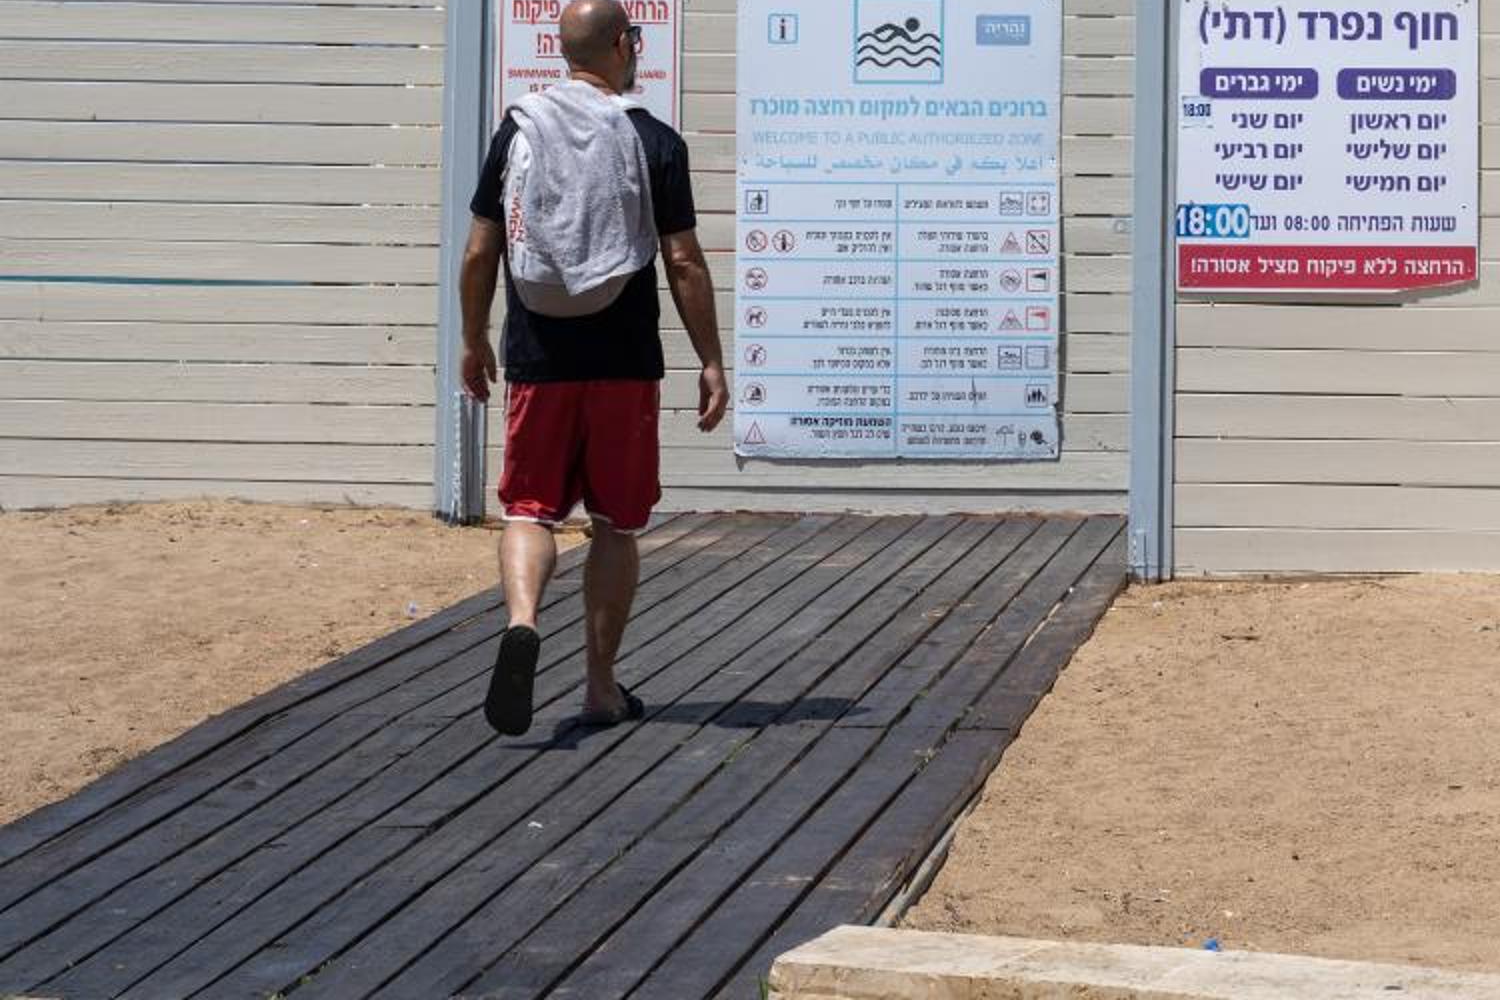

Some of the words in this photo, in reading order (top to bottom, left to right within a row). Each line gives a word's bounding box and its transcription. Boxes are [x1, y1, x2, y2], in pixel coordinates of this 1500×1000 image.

[513, 0, 561, 25] פיקוח
[625, 0, 669, 20] הרחצ
[1298, 10, 1382, 41] נפרד
[1394, 10, 1460, 50] חוף
[508, 69, 561, 79] SWIMMING
[1215, 75, 1269, 91] גברים
[1276, 75, 1303, 92] ימי
[1356, 75, 1404, 92] נשים
[1410, 76, 1437, 92] ימי
[750, 98, 799, 116] מוכרז
[804, 99, 854, 116] רחצה
[860, 95, 920, 120] למקום
[925, 99, 983, 116] הבאים
[989, 100, 1047, 117] ברוכים
[1231, 113, 1268, 129] שני
[1274, 113, 1303, 129] יום
[1350, 113, 1411, 134] ראשון
[1418, 113, 1447, 130] יום
[752, 130, 818, 145] WELCOME
[823, 131, 841, 144] TO
[845, 132, 854, 144] A
[858, 131, 905, 145] PUBLIC
[1008, 132, 1043, 146] ZONE
[1214, 143, 1268, 160] רביעי
[1274, 143, 1303, 159] יום
[1345, 140, 1411, 160] שלישי
[1418, 143, 1447, 160] יום
[1215, 174, 1267, 190] שישי
[1274, 174, 1303, 190] יום
[1345, 175, 1411, 192] חמישי
[1418, 175, 1447, 192] יום
[1177, 206, 1249, 236] 18:00
[1284, 215, 1330, 231] 08:00
[1338, 216, 1403, 232] הפתיחה
[1411, 216, 1457, 232] שעות
[1191, 257, 1251, 273] אסורה!
[1257, 257, 1299, 274] מציל
[1306, 259, 1356, 277] פיקוח
[1363, 257, 1397, 274] ללא
[1404, 259, 1464, 275] הרחצה
